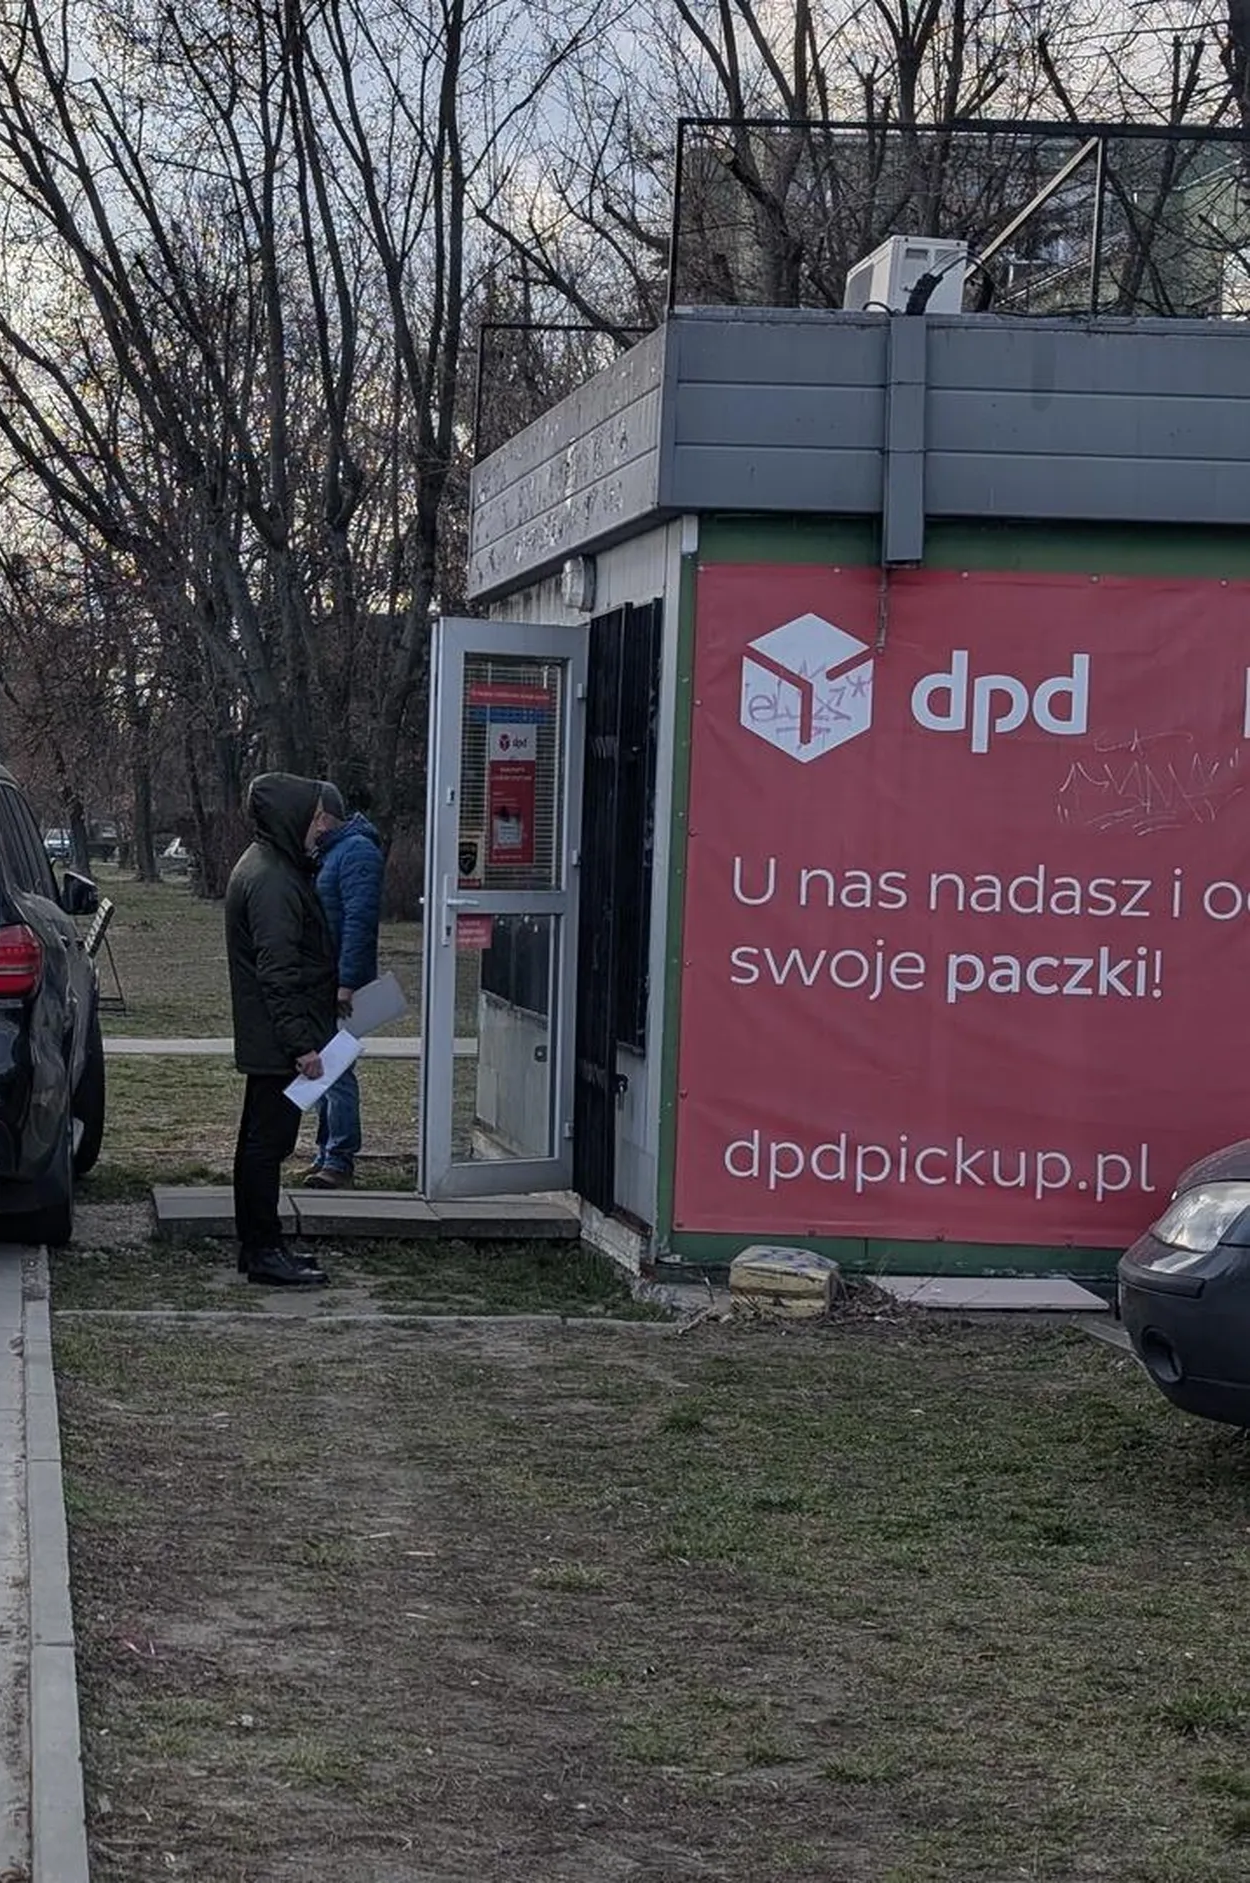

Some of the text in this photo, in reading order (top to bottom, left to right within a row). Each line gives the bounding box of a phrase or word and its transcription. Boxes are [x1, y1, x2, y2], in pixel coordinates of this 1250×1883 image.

[910, 649, 1090, 754] dpd
[732, 855, 1250, 921] U nas nadasz i o
[729, 938, 1163, 1005] swoje paczki!
[723, 1128, 1156, 1202] dpdpickup.pl
